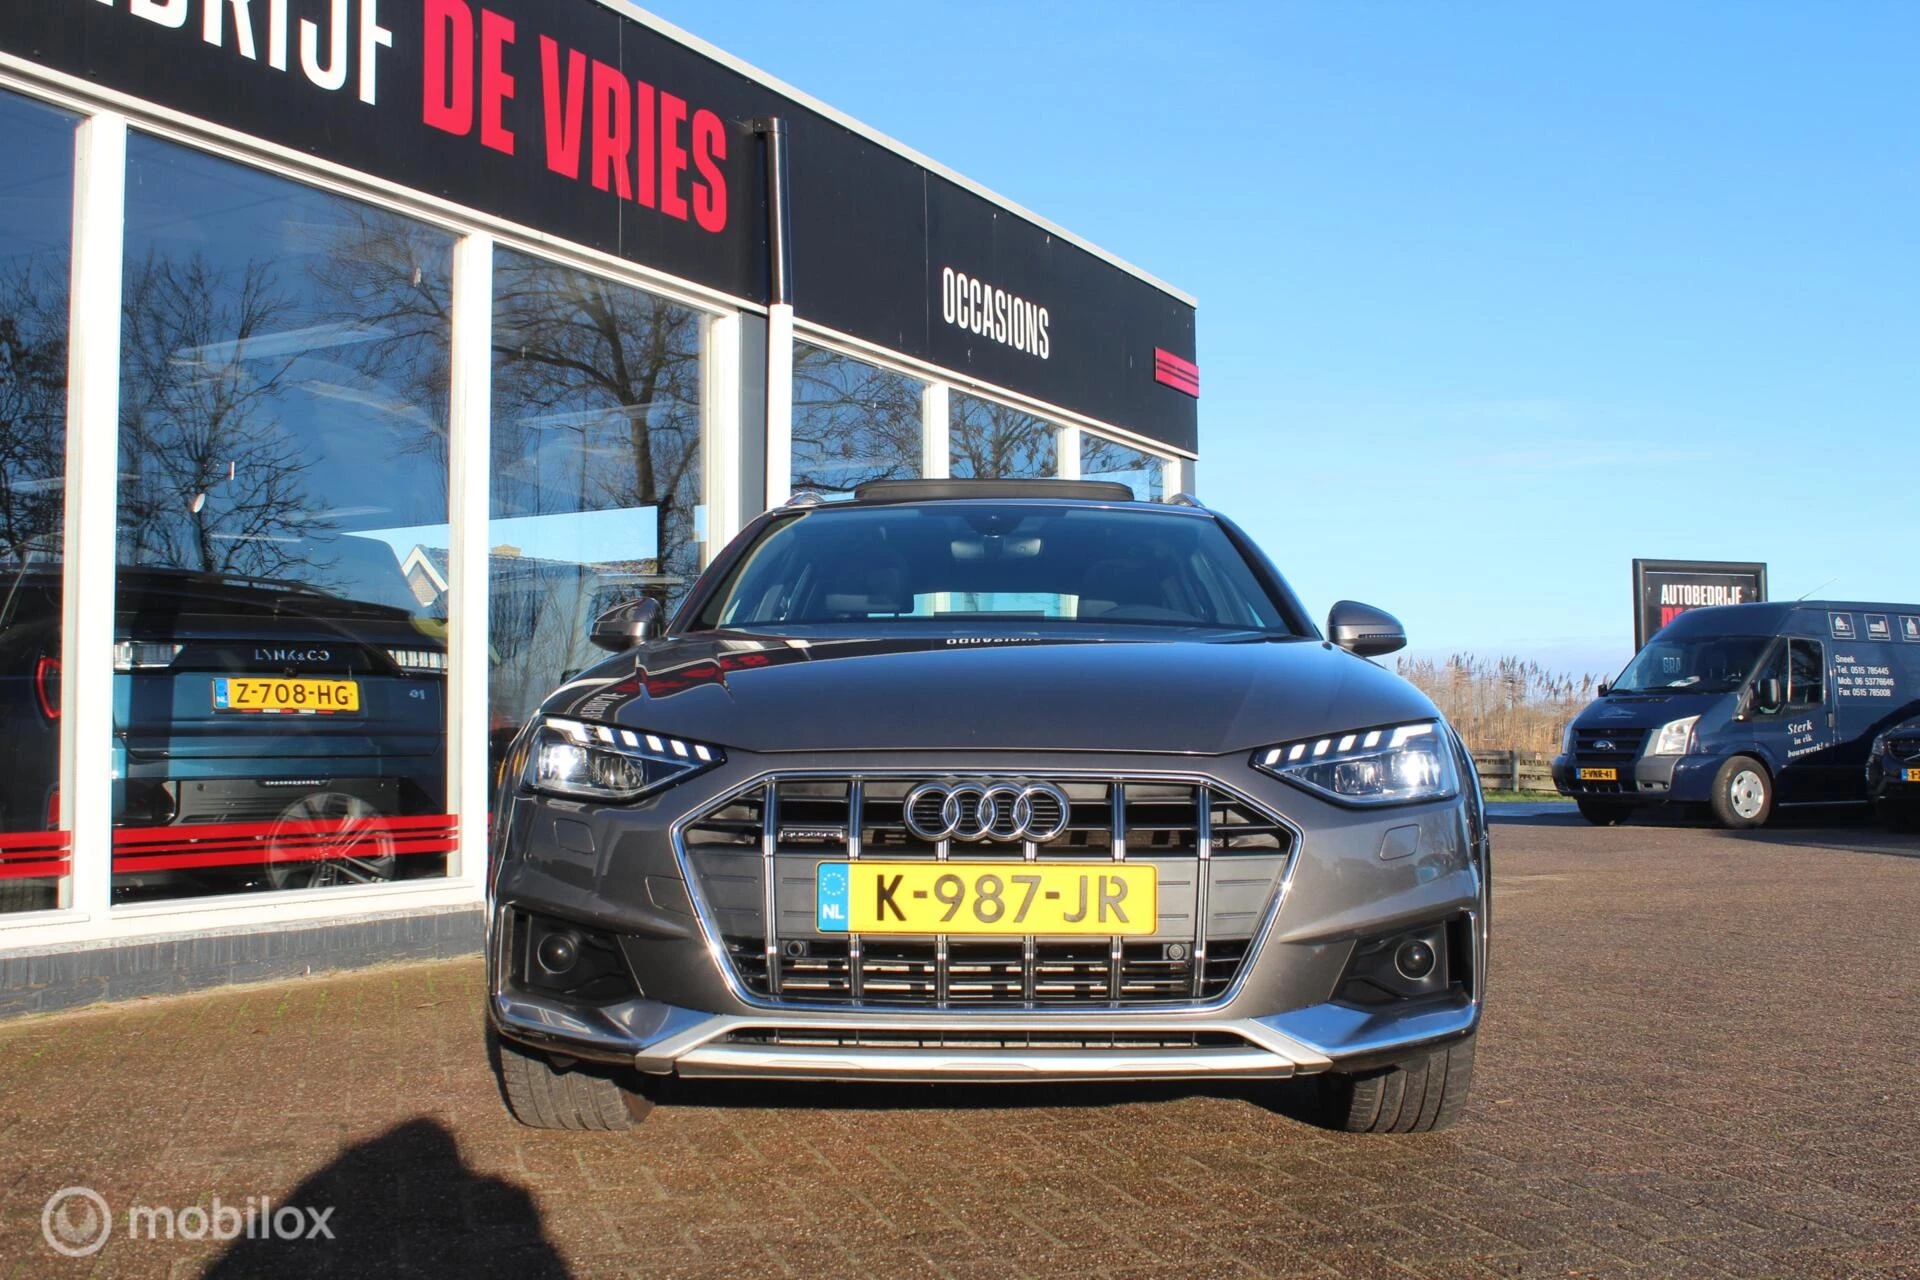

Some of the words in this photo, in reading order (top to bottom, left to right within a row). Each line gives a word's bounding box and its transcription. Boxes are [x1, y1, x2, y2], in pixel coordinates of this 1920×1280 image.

[422, 0, 515, 156] DE
[539, 33, 727, 233] VRIES
[943, 266, 1049, 360] OCCASIONS
[236, 683, 350, 705] Z-708-HG
[1787, 719, 1813, 735] Sterk
[822, 904, 845, 920] NL
[876, 873, 1130, 924] K-987-JR
